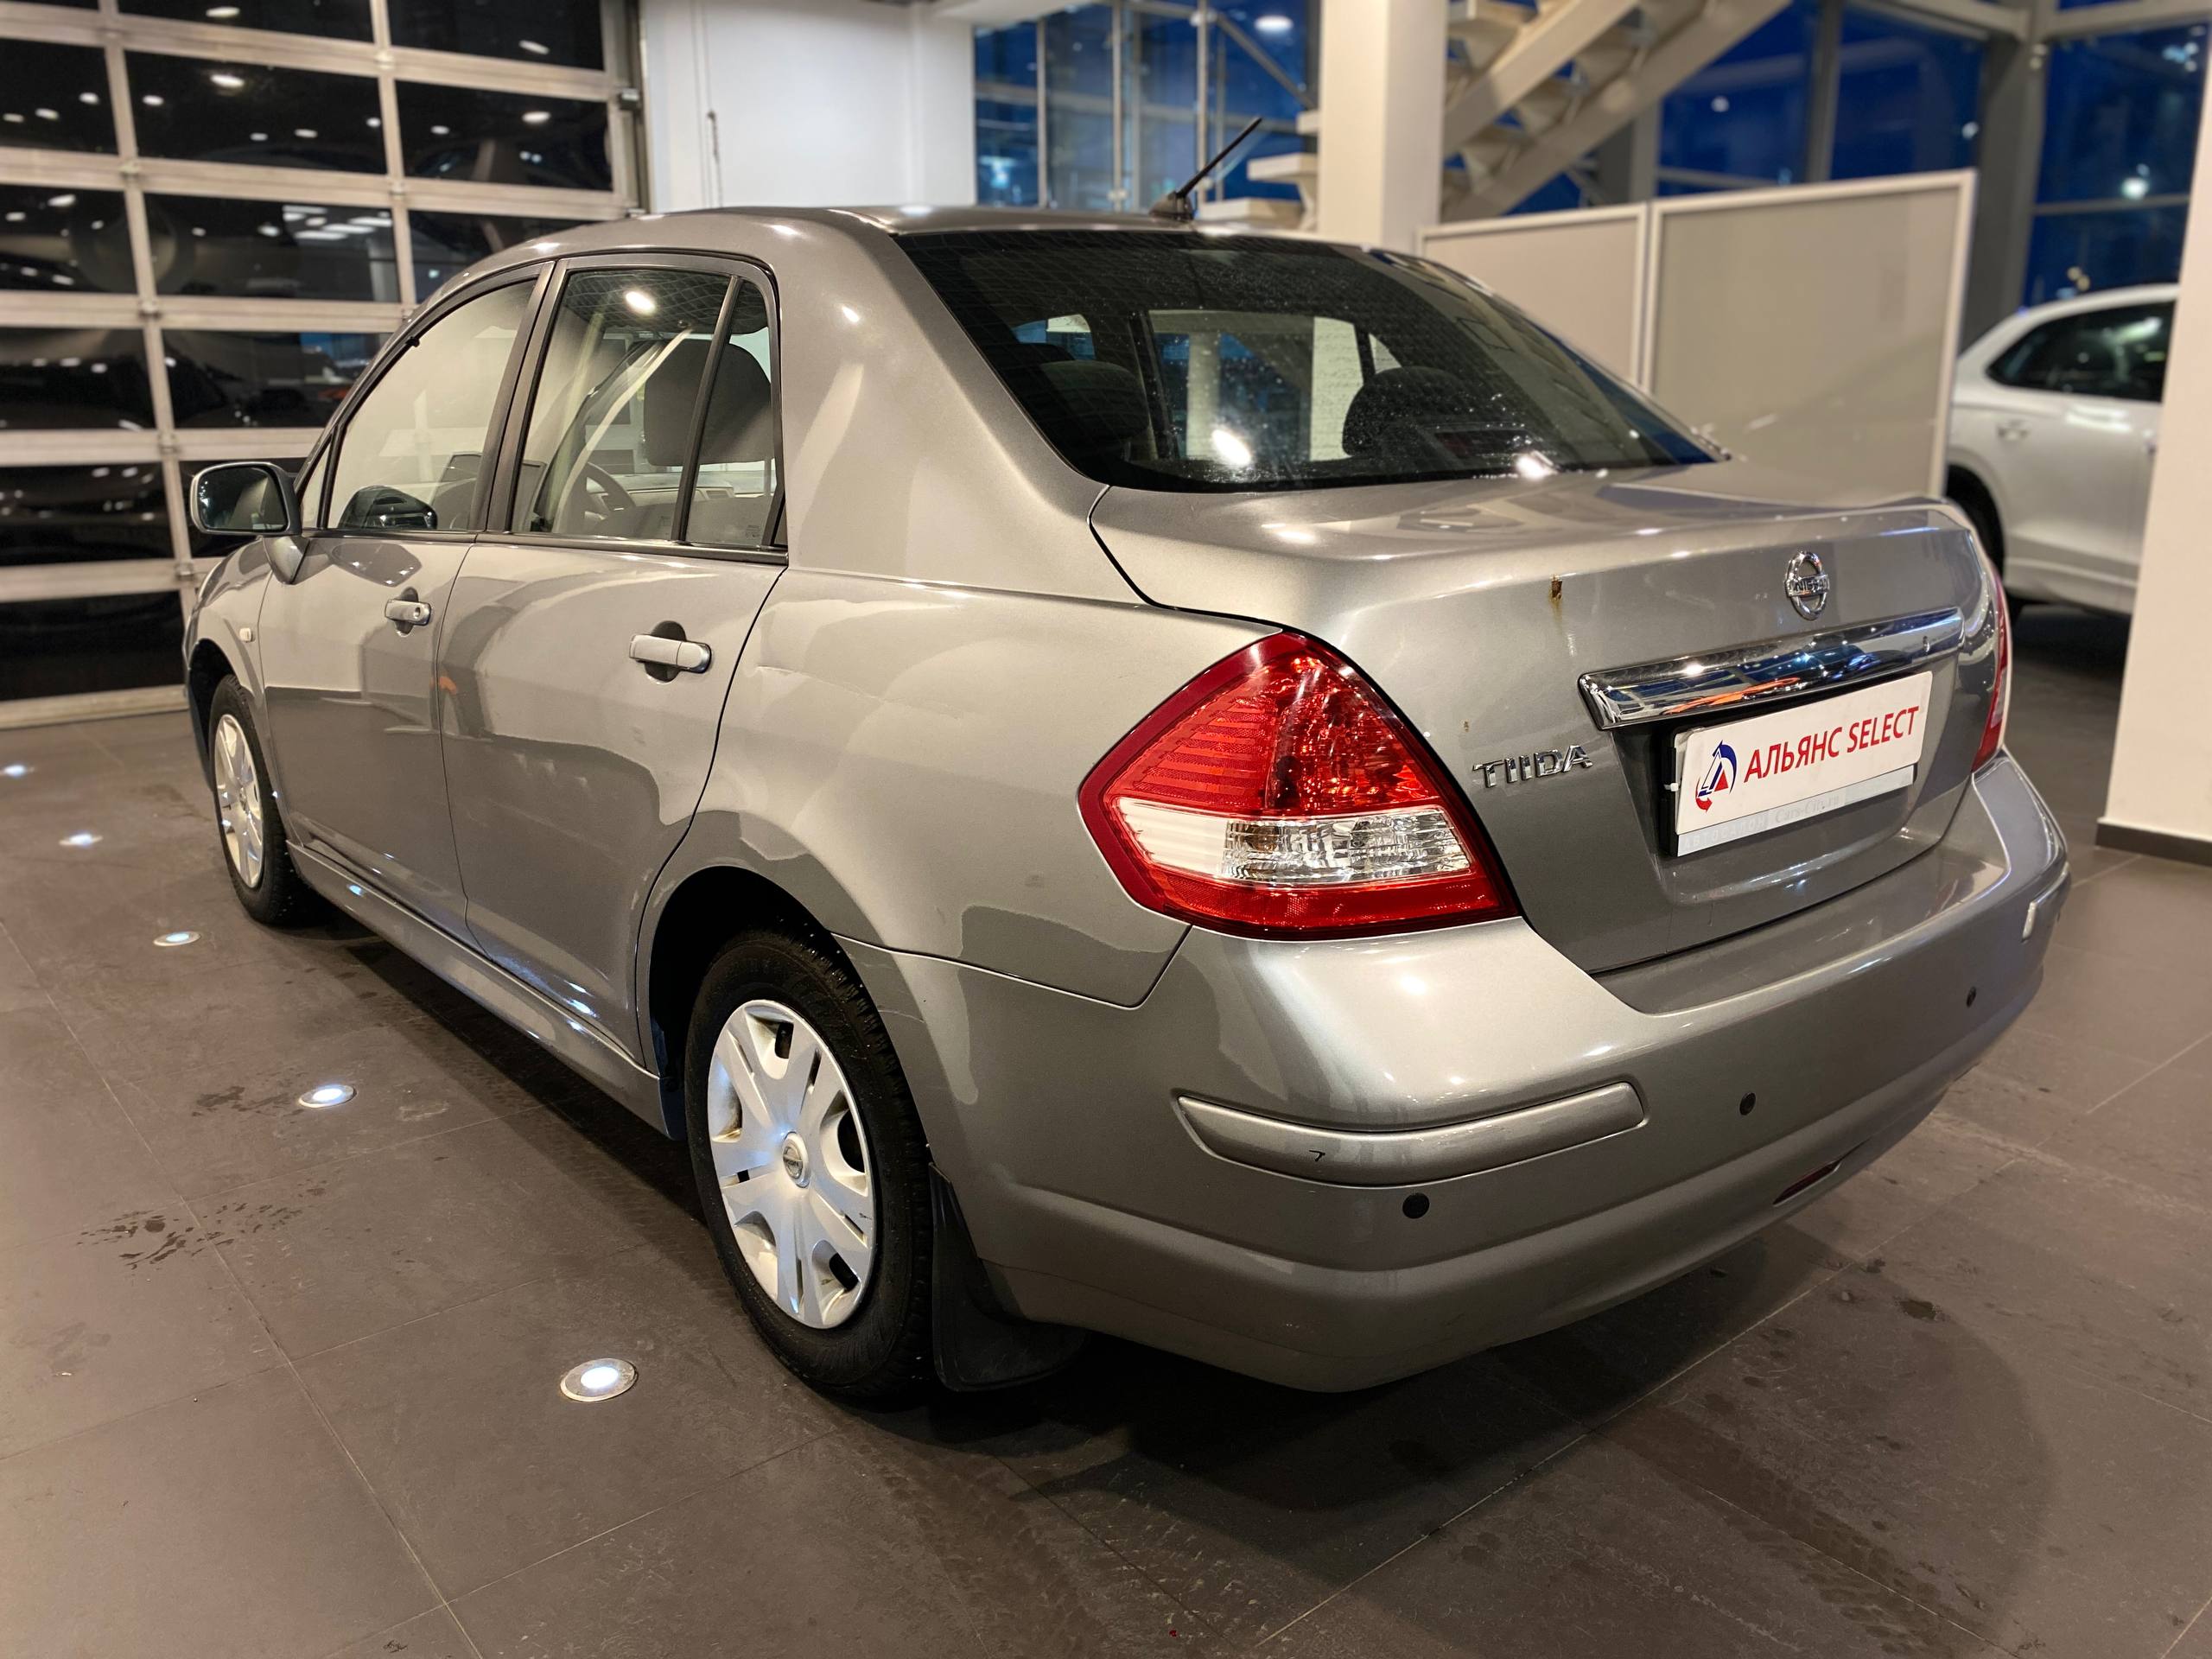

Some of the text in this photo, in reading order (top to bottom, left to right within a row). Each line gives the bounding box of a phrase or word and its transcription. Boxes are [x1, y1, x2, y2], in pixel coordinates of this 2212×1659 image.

[1472, 745, 1592, 788] TIIDA
[1744, 706, 1919, 782] АЛЬЯНС SELECT
